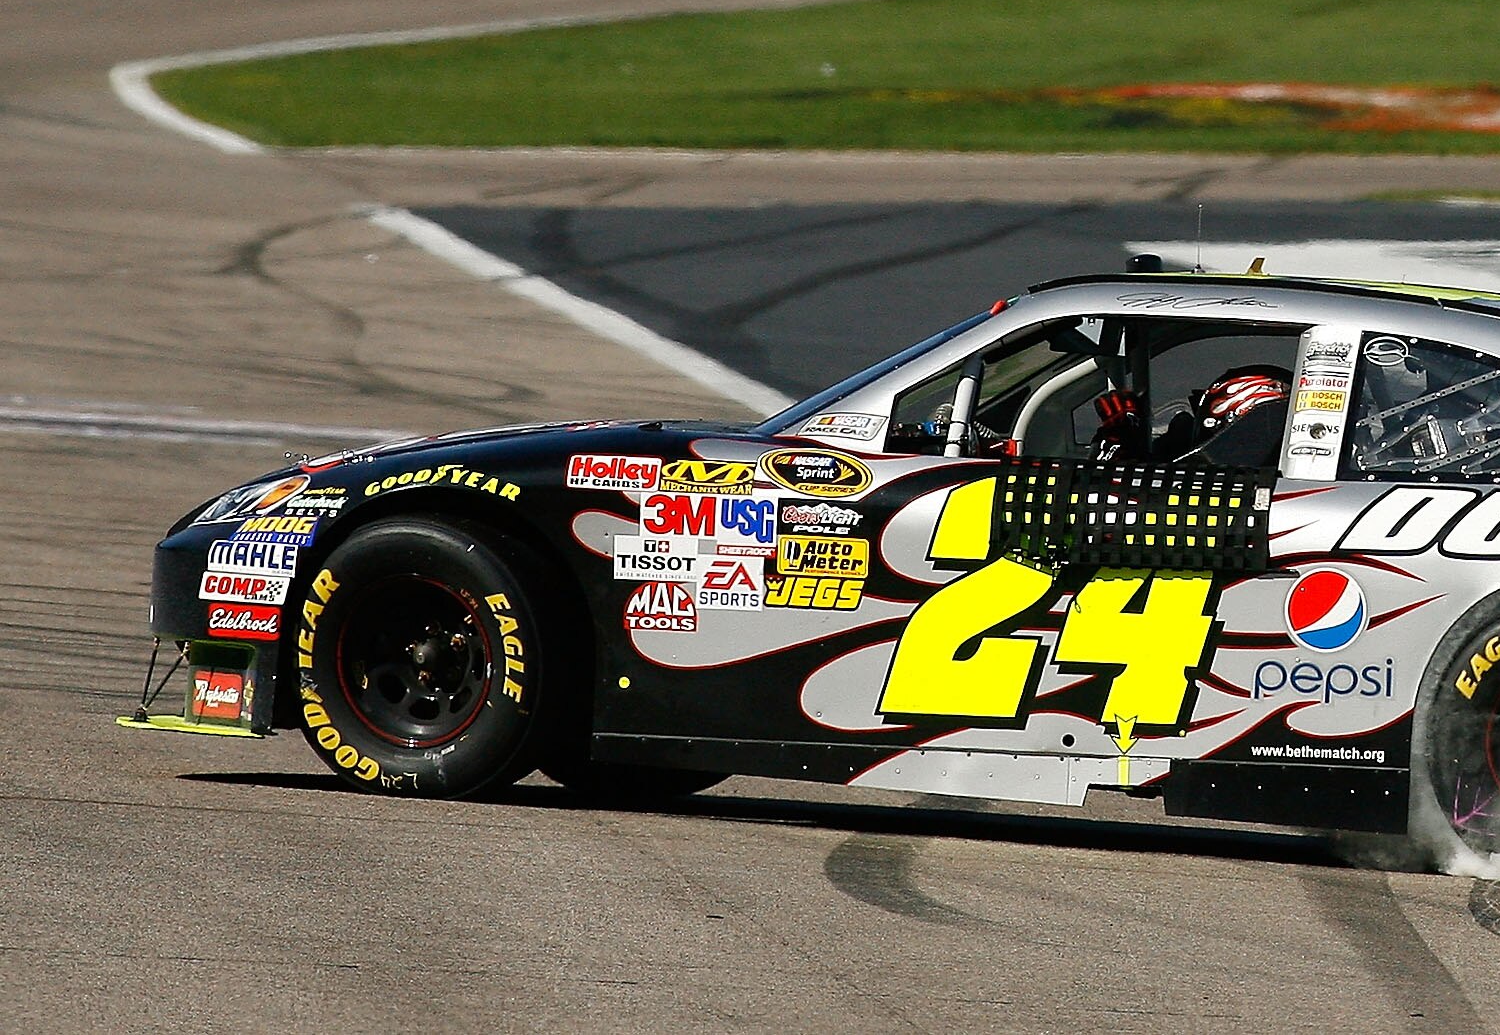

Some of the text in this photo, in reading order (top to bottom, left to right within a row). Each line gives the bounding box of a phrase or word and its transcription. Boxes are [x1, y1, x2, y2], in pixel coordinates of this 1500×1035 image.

[1310, 401, 1341, 410] BOSCH
[1312, 392, 1343, 401] BOSCH
[833, 416, 869, 427] NASCAR
[792, 455, 832, 467] NASCAR
[570, 478, 585, 486] HP
[571, 457, 658, 489] Holley
[796, 467, 834, 479] Sprint
[365, 465, 521, 501] GOODYEAR
[660, 480, 752, 494] MECHANIX WEAR
[822, 485, 857, 493] SERIES
[285, 508, 338, 518] BELTS
[643, 495, 717, 537] 3M
[721, 498, 775, 544] USG
[820, 507, 863, 526] LIGHT
[236, 516, 319, 534] MOOG
[792, 525, 850, 535] POLE
[209, 542, 296, 571] MAHLE
[803, 541, 853, 556] Auto
[616, 554, 697, 572] TISSOT
[799, 555, 863, 571] Meter
[702, 561, 757, 591] EA
[204, 575, 267, 596] COMP
[765, 577, 865, 609] JEGS
[626, 582, 695, 617] MAC
[699, 591, 760, 608] SPORTS
[874, 476, 1213, 725] 24
[209, 609, 278, 633] Edelbrock
[625, 615, 695, 630] TOOLS
[484, 592, 525, 704] EAGLE
[1253, 658, 1393, 704] pepsi
[1251, 745, 1385, 763] www.bethematch.org
